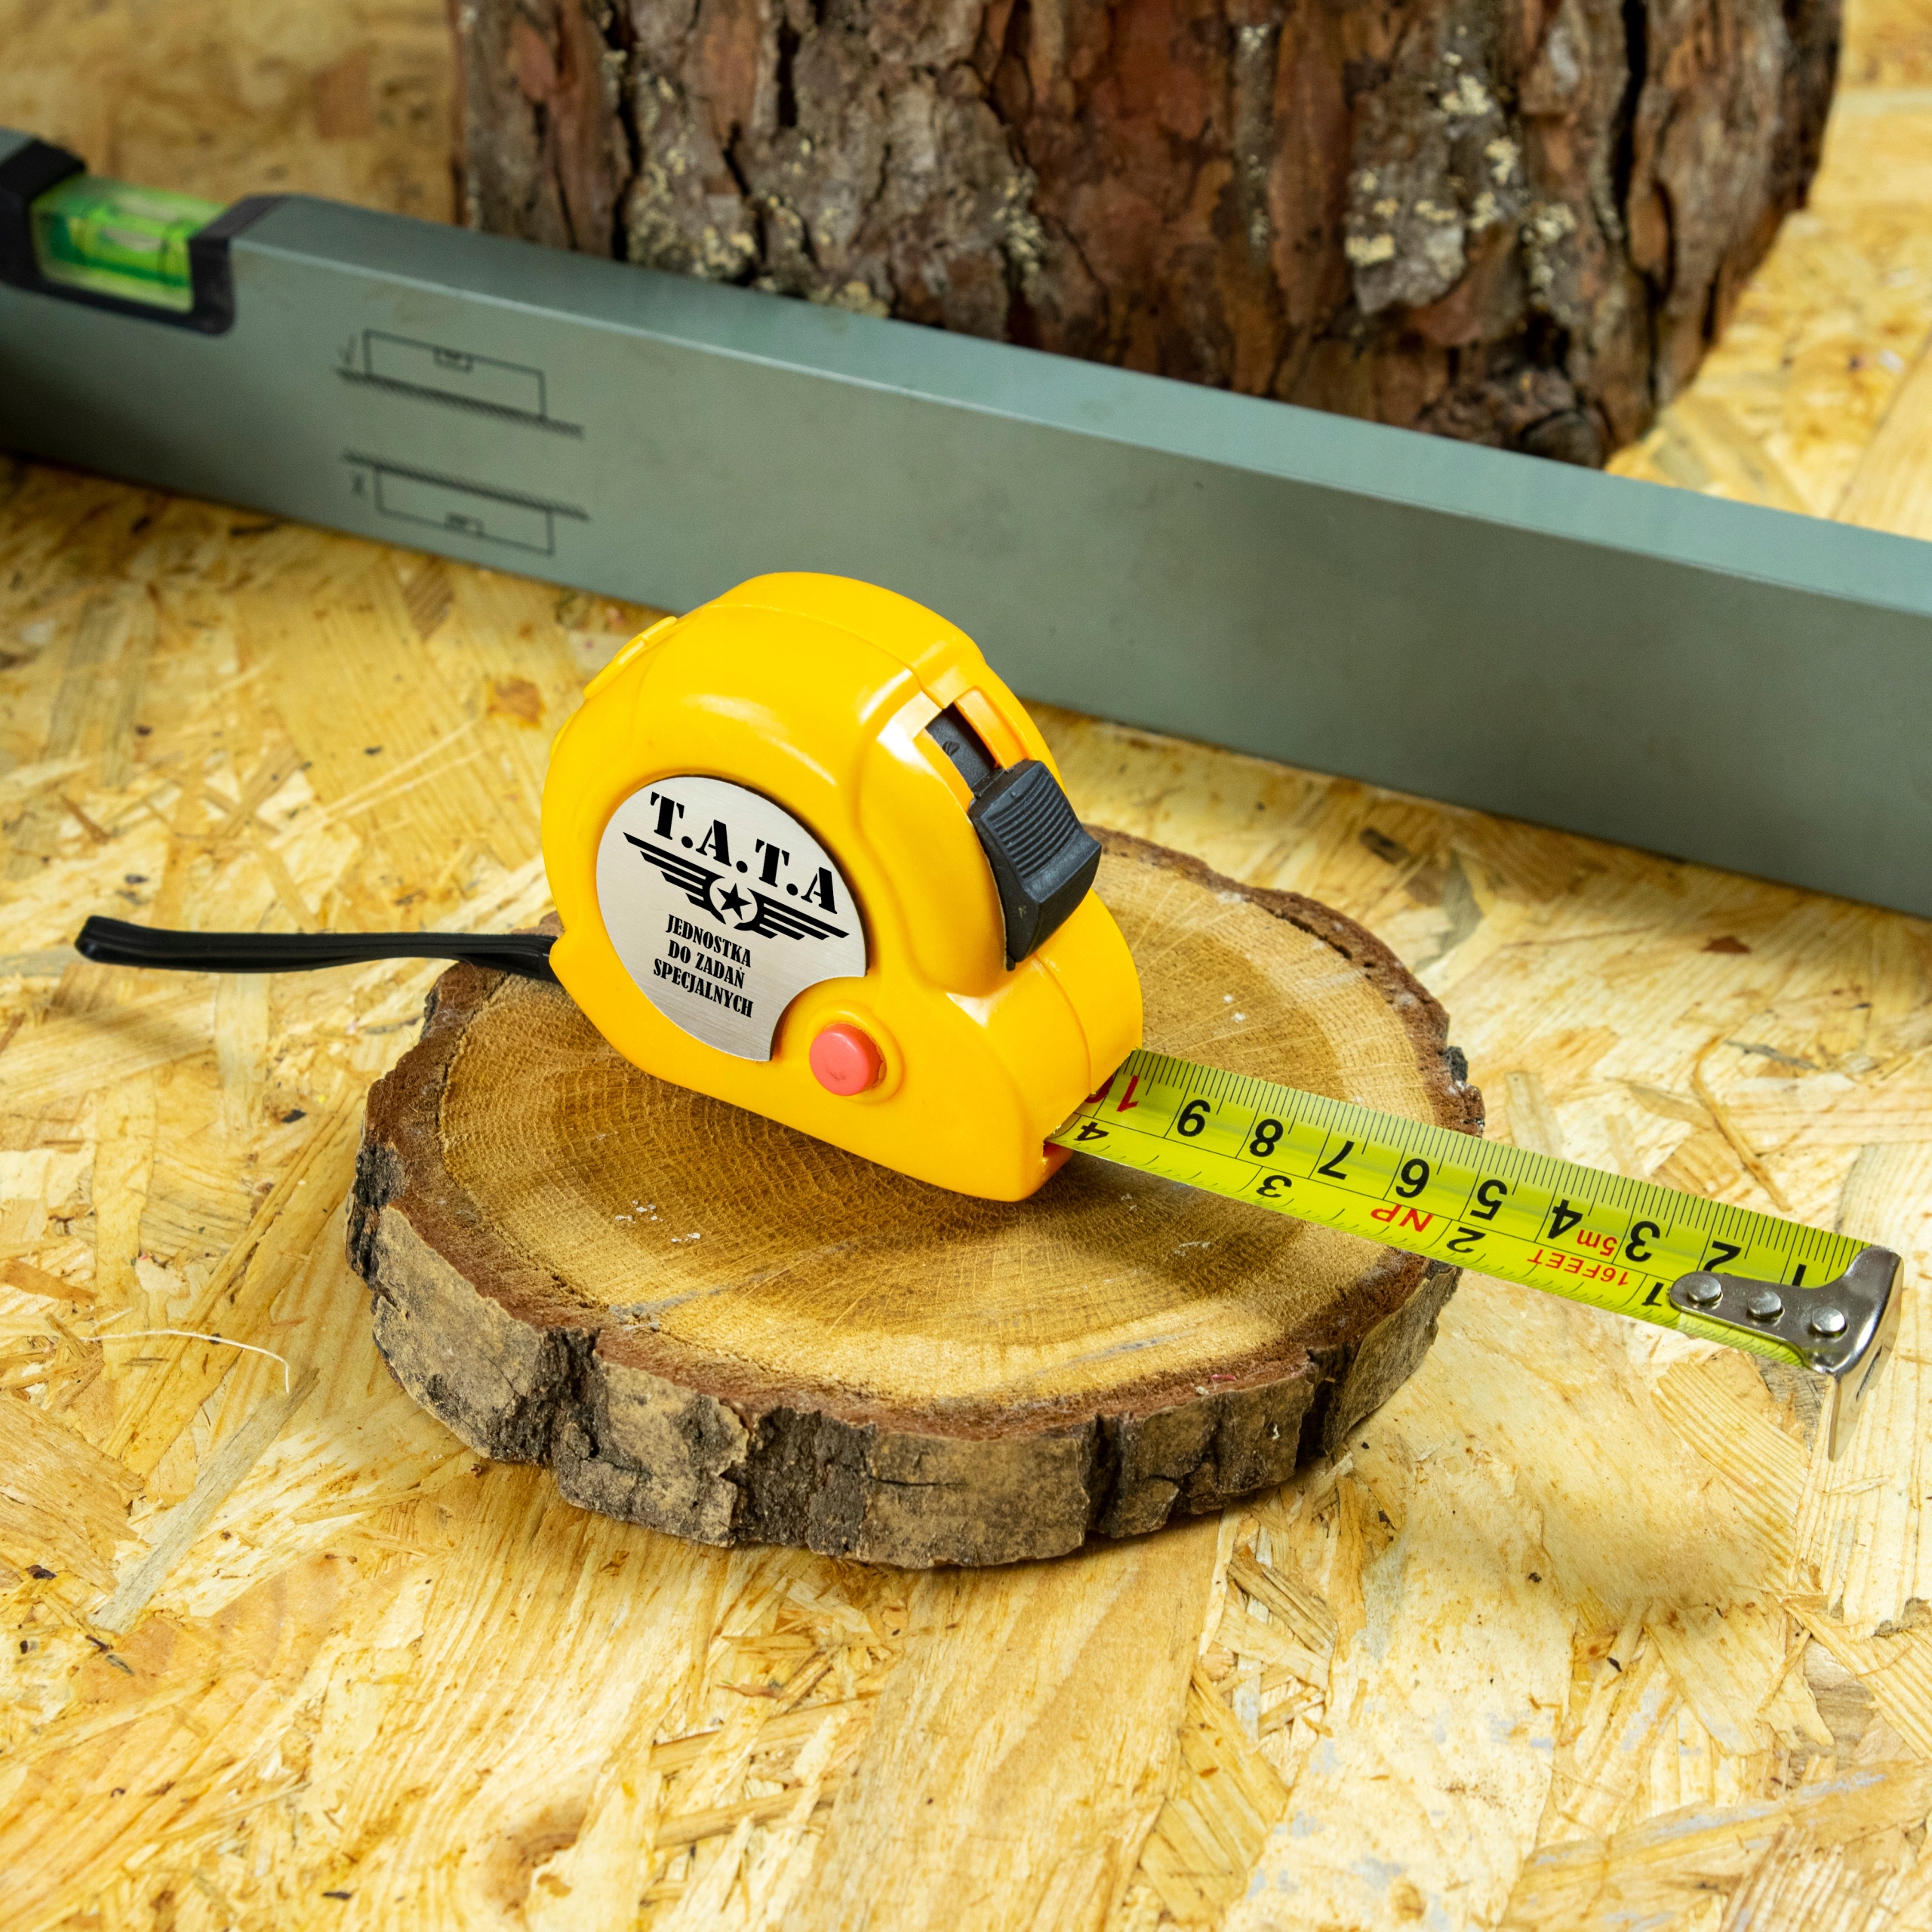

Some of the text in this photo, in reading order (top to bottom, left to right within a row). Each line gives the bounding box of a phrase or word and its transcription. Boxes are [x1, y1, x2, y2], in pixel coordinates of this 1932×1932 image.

[651, 792, 838, 915] T.A.T.A
[666, 915, 752, 968] JEDNOSTKA
[668, 940, 746, 989] DO ZADAŃ
[654, 958, 754, 1019] SPECJALNYCH
[1177, 1099, 1211, 1137] 9
[1249, 1118, 1284, 1158] 8
[1317, 1140, 1355, 1180] 7
[1395, 1158, 1430, 1198] 6
[1073, 1121, 1664, 1306] 1 2 3 4
[1371, 1204, 1433, 1232] NP
[1470, 1179, 1508, 1221] 5
[1547, 1198, 1583, 1239] 4
[1577, 1229, 1618, 1257] 5m
[1625, 1220, 1660, 1262] 3
[1703, 1240, 1742, 1275] 2
[1527, 1249, 1629, 1286] 16FEET
